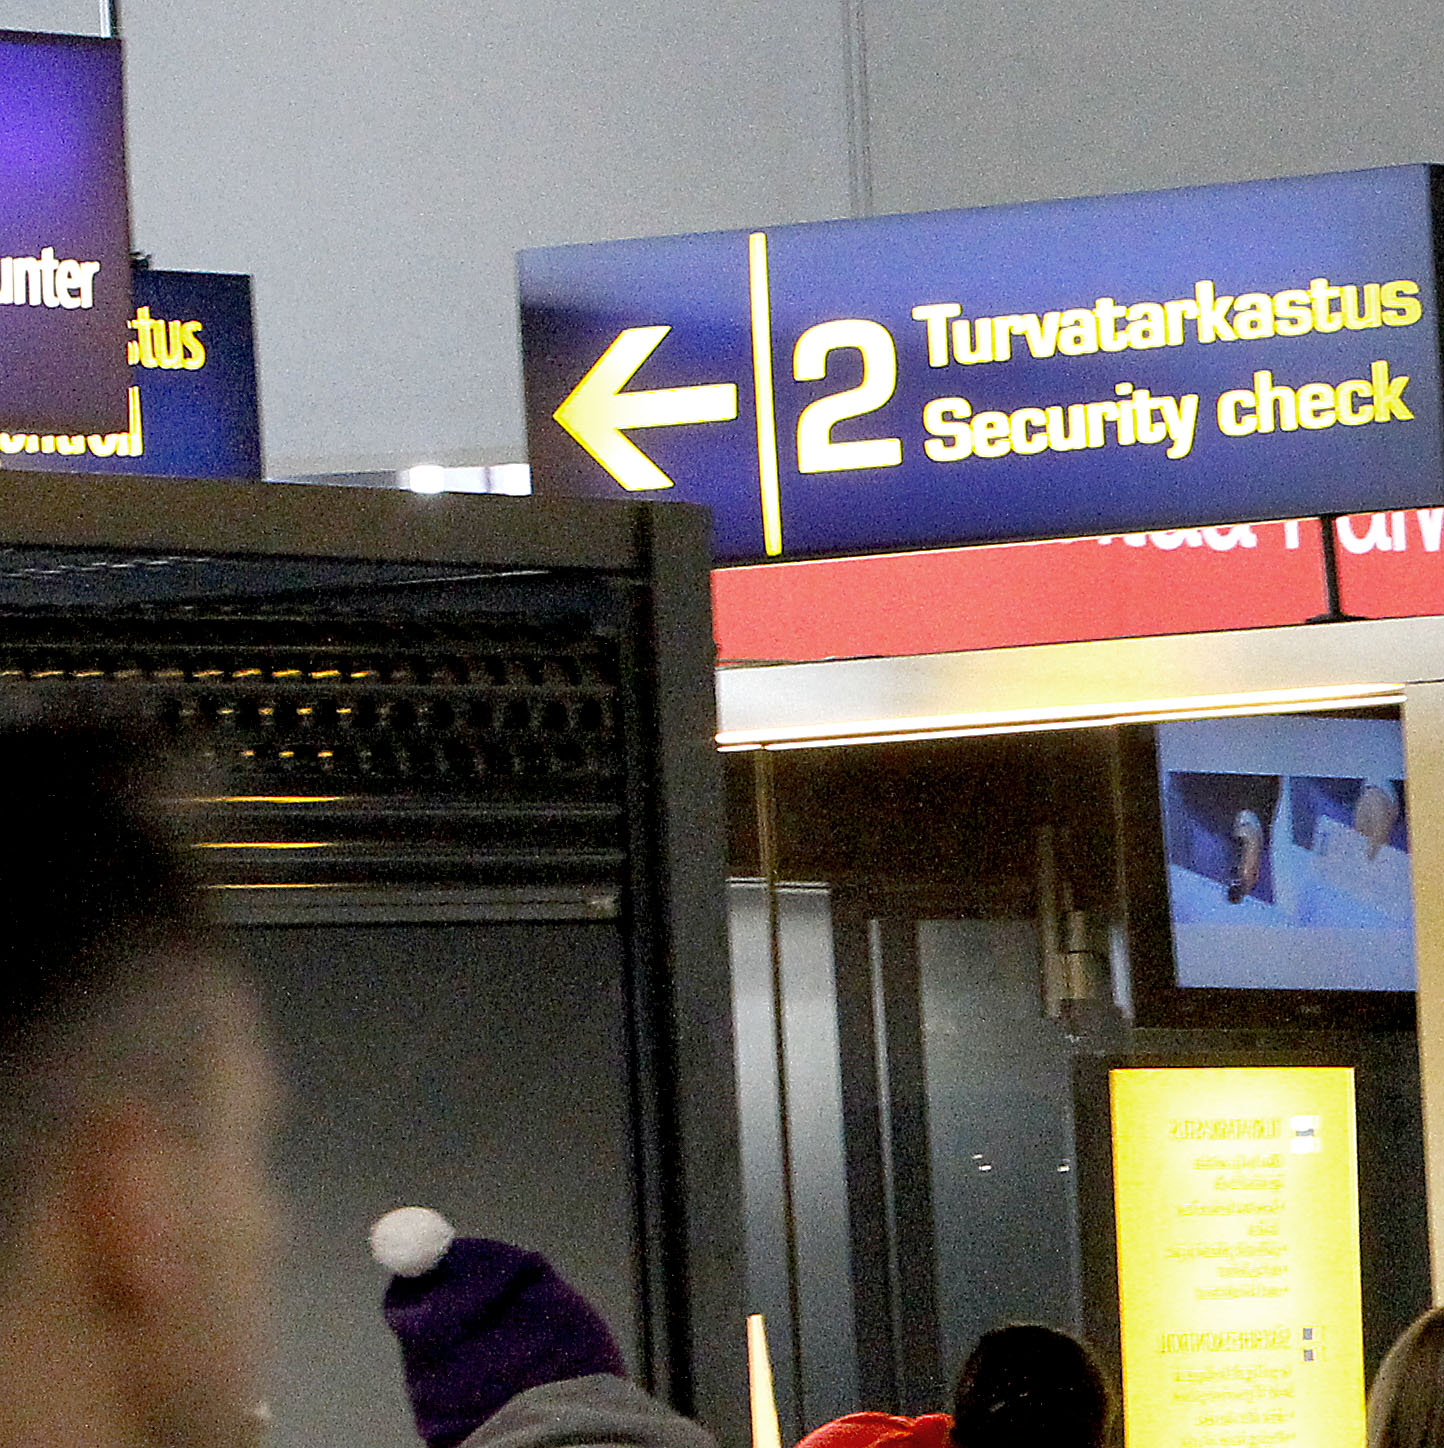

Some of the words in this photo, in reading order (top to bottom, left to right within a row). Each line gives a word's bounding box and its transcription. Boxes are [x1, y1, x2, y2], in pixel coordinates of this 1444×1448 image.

[912, 279, 1423, 369] Turvatarkastus
[793, 319, 903, 475] 2
[922, 382, 1199, 460] Security
[1217, 360, 1416, 437] check
